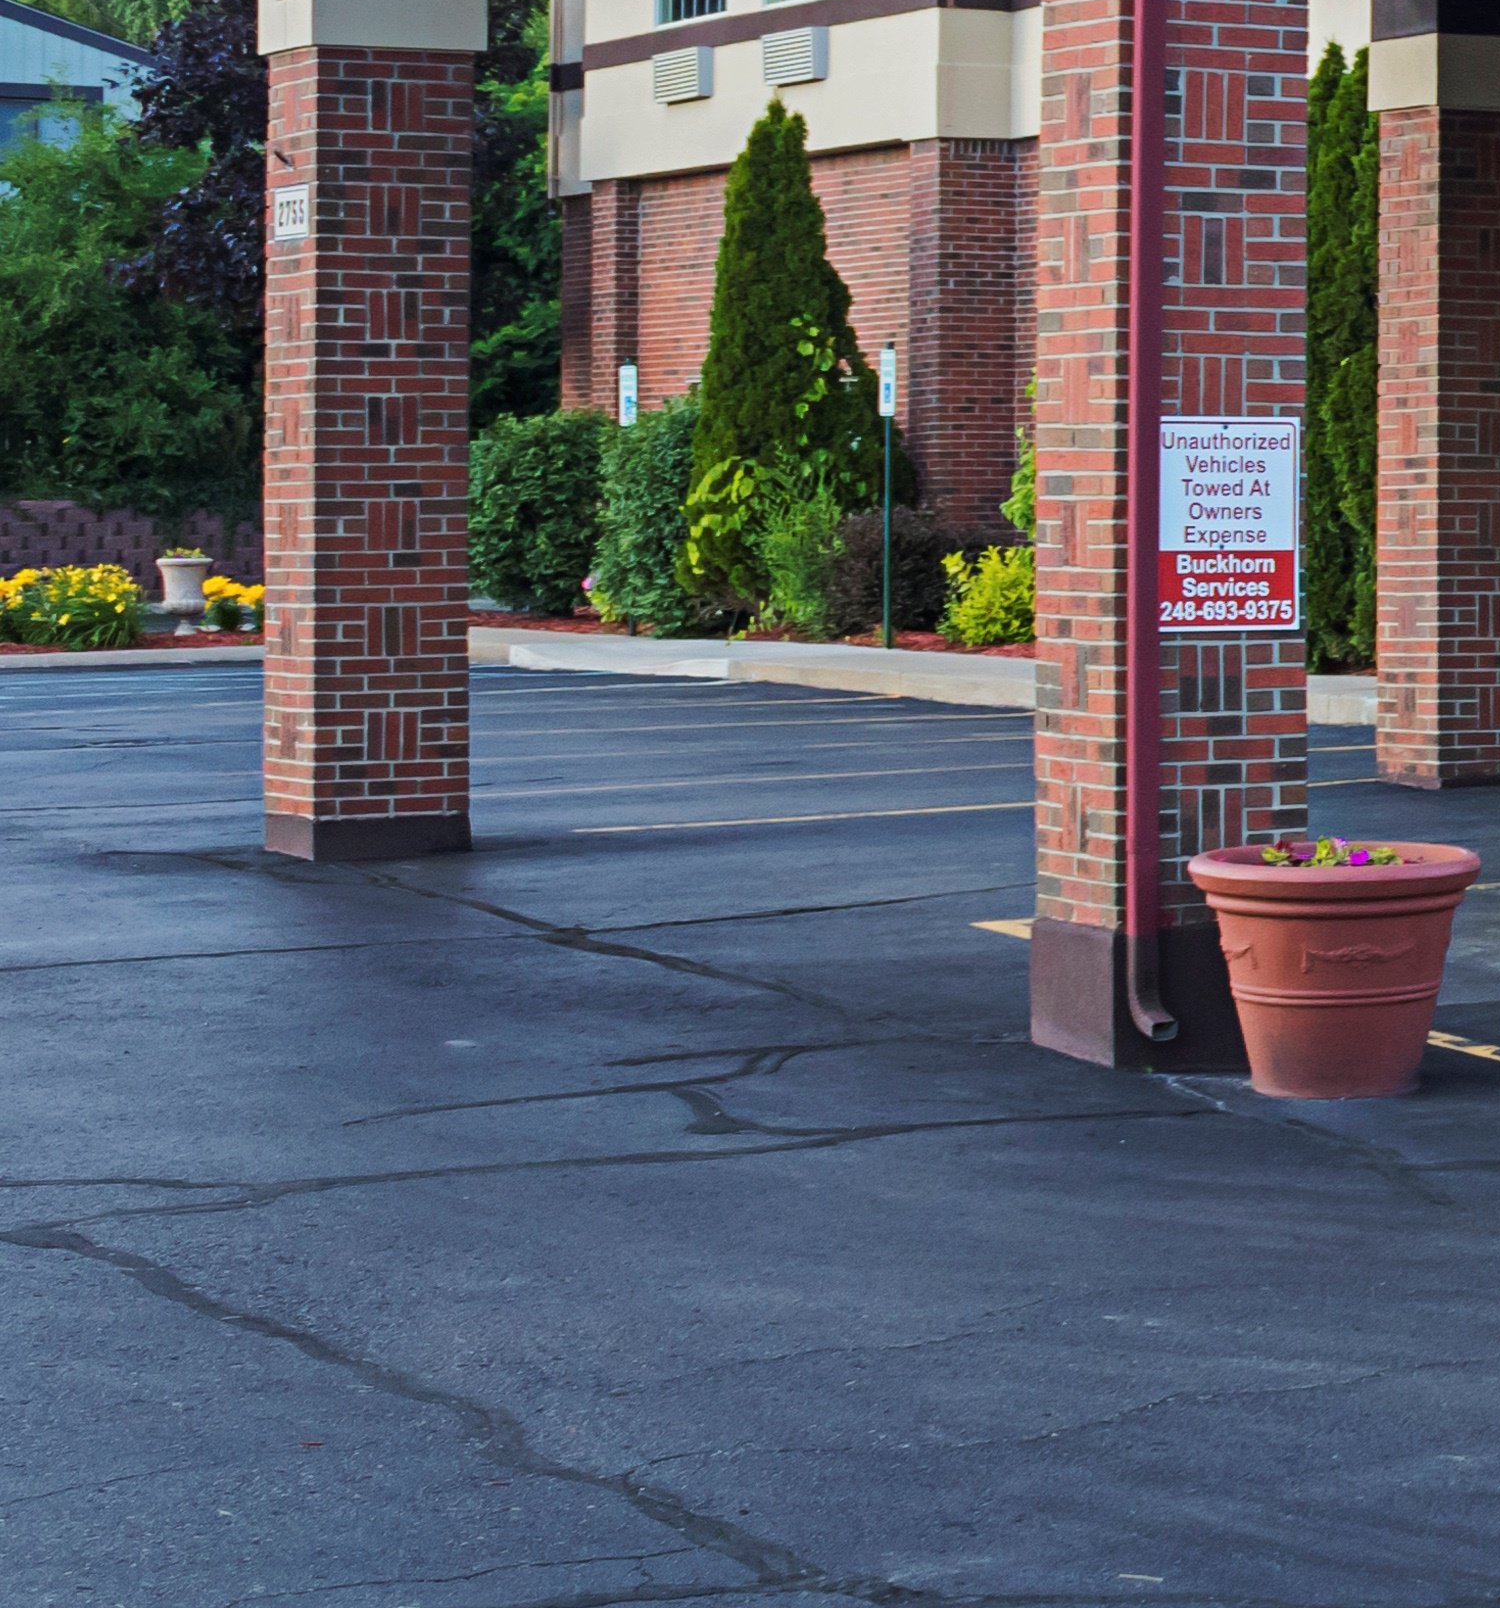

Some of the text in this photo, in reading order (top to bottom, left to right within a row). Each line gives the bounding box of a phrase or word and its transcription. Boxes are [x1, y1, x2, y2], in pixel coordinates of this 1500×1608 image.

[278, 198, 305, 228] 2755
[1161, 431, 1292, 450] Unauthorized
[1185, 455, 1267, 473] Vehicles
[1181, 478, 1271, 497] Towed At
[1188, 502, 1263, 520] Owners
[1184, 525, 1267, 548] Expense
[1175, 553, 1276, 574] Buckhorn
[1182, 577, 1270, 598] Services
[1159, 599, 1293, 622] 248-693-9375
